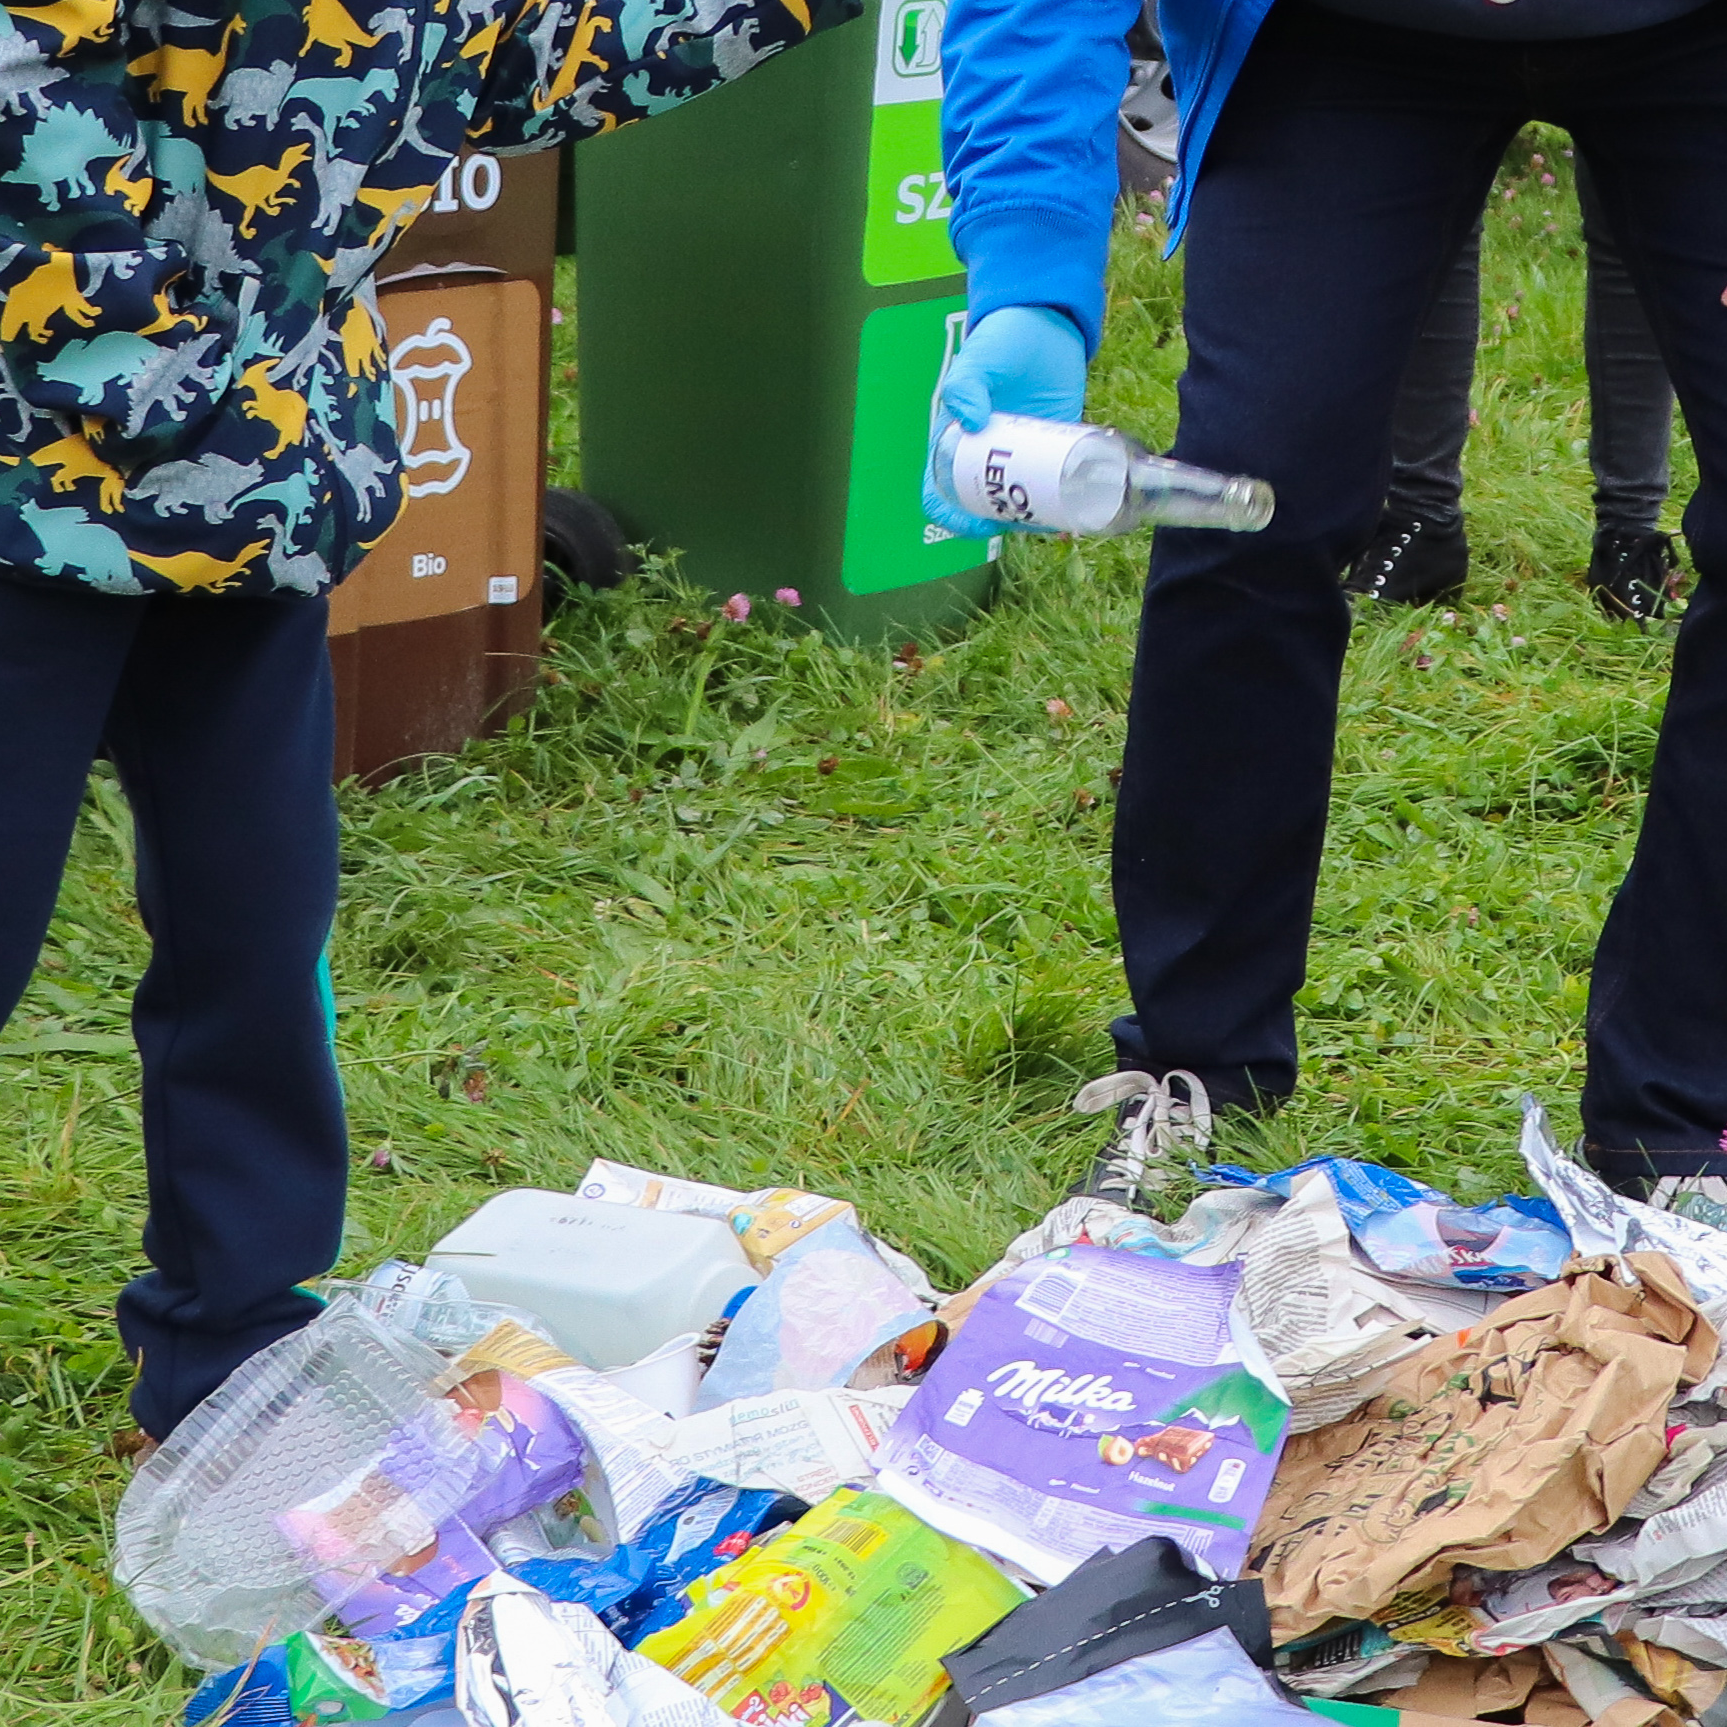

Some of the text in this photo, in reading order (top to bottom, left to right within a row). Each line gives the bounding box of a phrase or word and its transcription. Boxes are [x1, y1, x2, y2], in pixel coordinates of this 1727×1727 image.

[424, 153, 502, 214] IO
[412, 552, 448, 578] Bio
[986, 1359, 1137, 1412] Milka
[1127, 1470, 1177, 1493] Hazelnut
